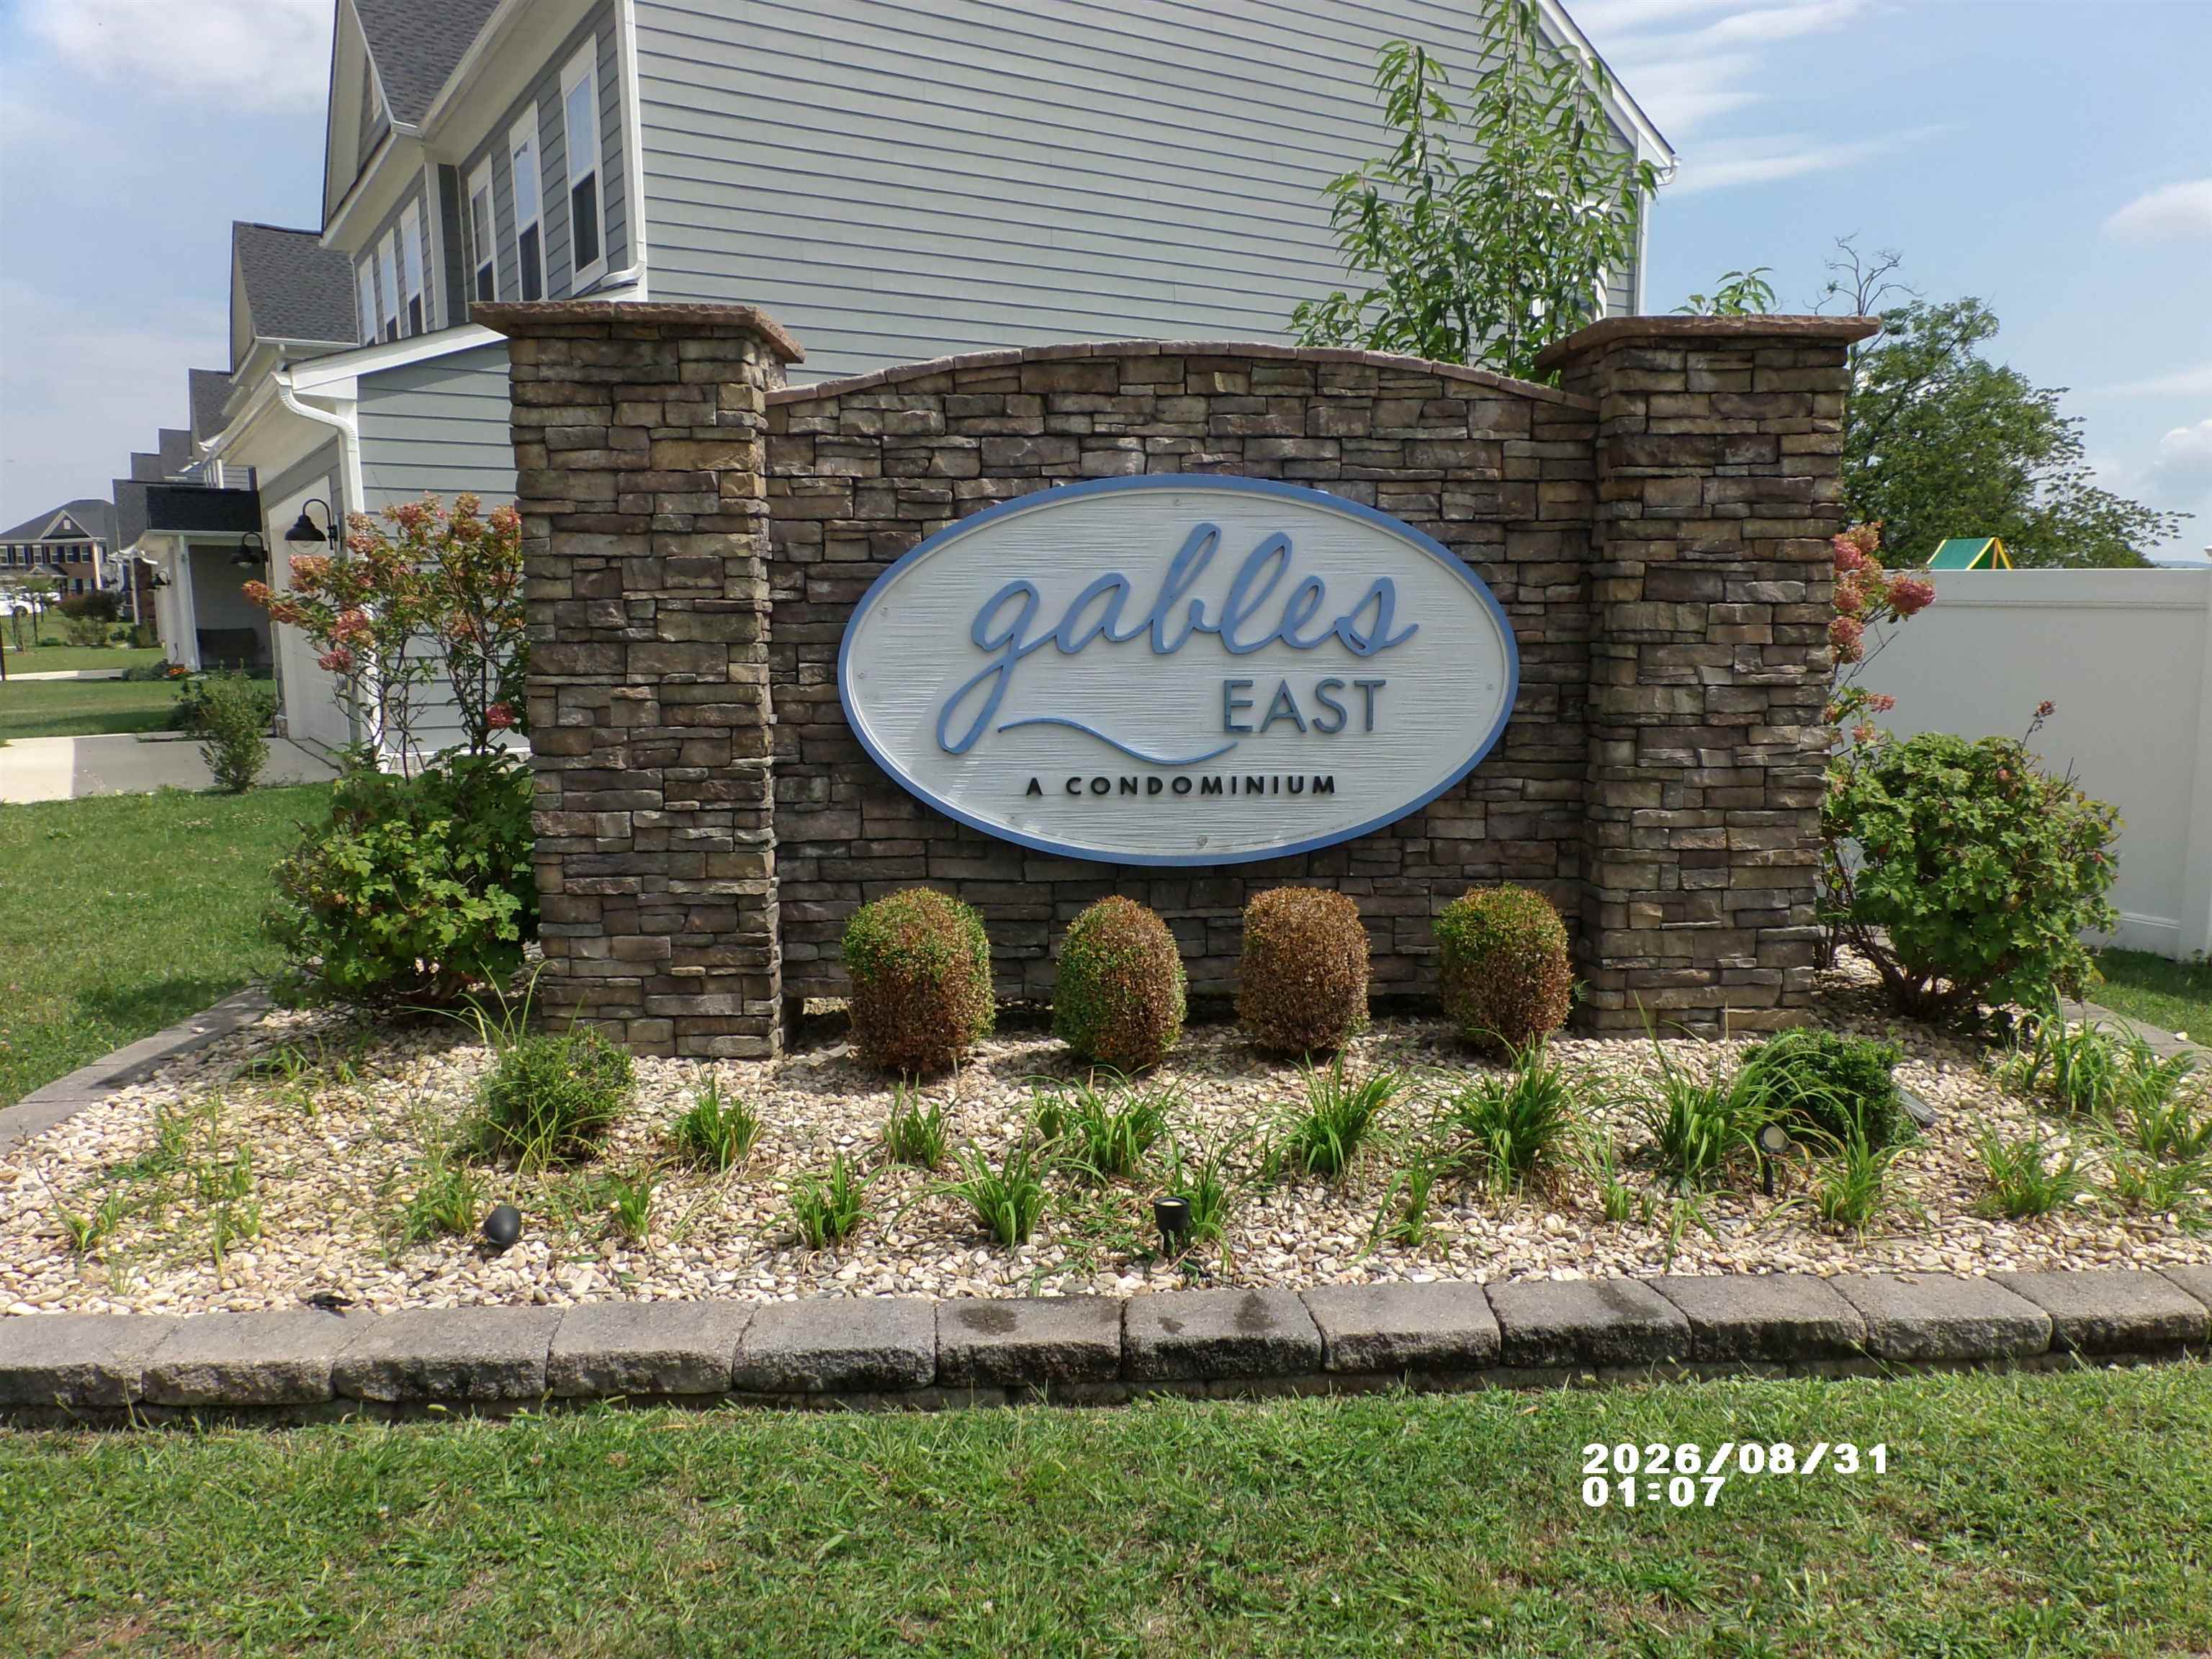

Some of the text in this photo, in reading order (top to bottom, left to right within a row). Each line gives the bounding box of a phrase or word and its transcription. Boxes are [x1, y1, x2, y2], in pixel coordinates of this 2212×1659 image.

[935, 521, 1420, 755] gables
[1223, 678, 1387, 734] EAST
[1025, 774, 1336, 796] A CONDOMINIUM
